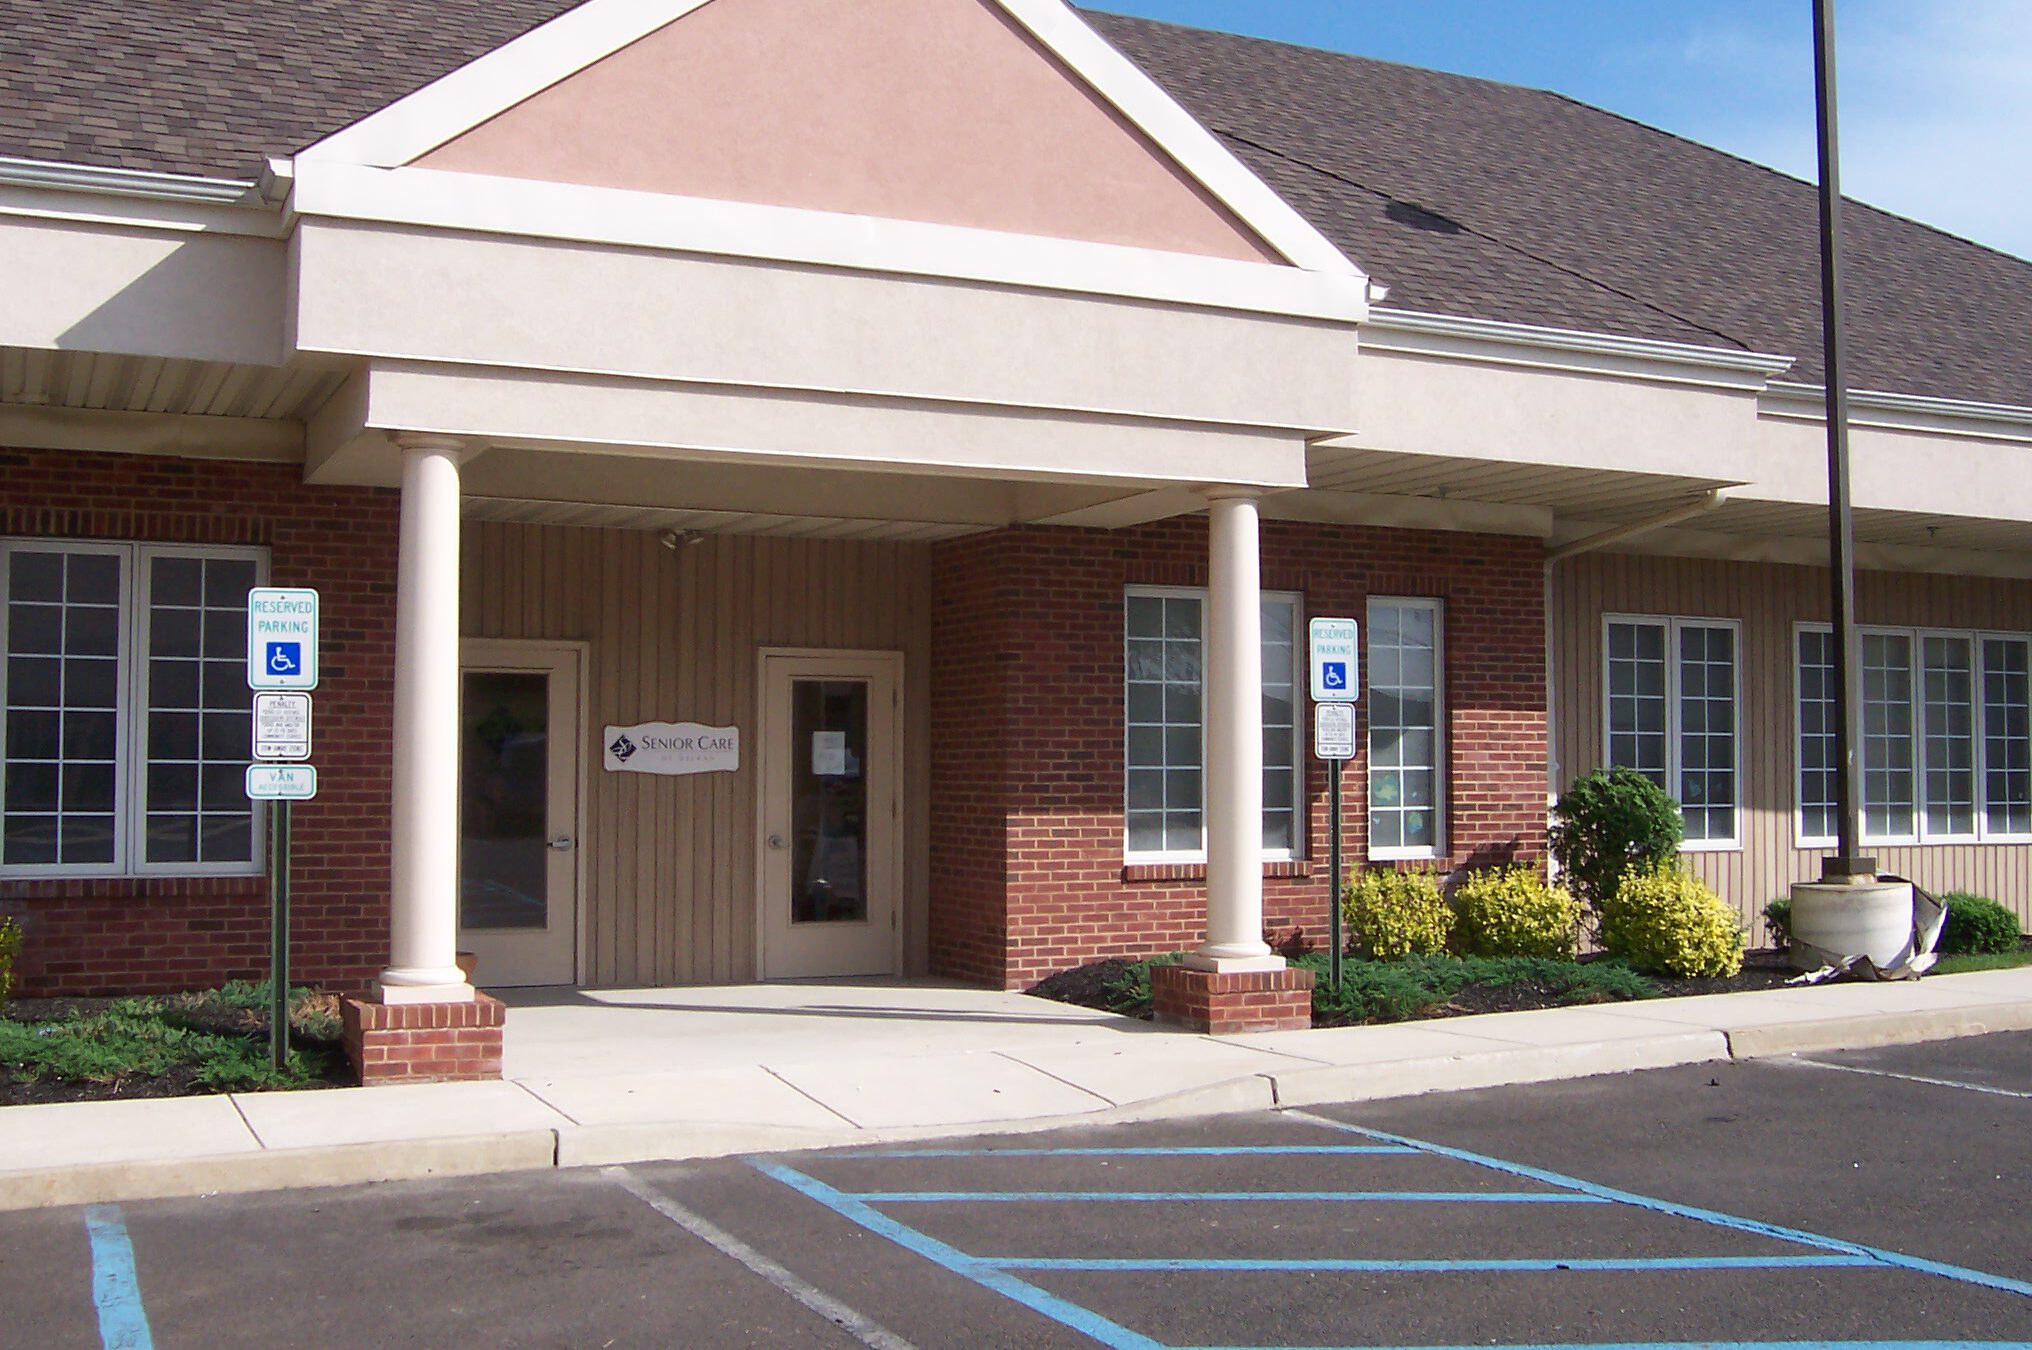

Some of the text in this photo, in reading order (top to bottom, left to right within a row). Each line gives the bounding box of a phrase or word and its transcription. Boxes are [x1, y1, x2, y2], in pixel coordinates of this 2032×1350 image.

[254, 601, 312, 614] RESERVED
[258, 621, 309, 633] PARKING
[1314, 629, 1354, 640] RESERVED
[1317, 645, 1352, 655] PARKING
[641, 735, 734, 750] SENIOR CARE
[269, 773, 294, 781] VAN
